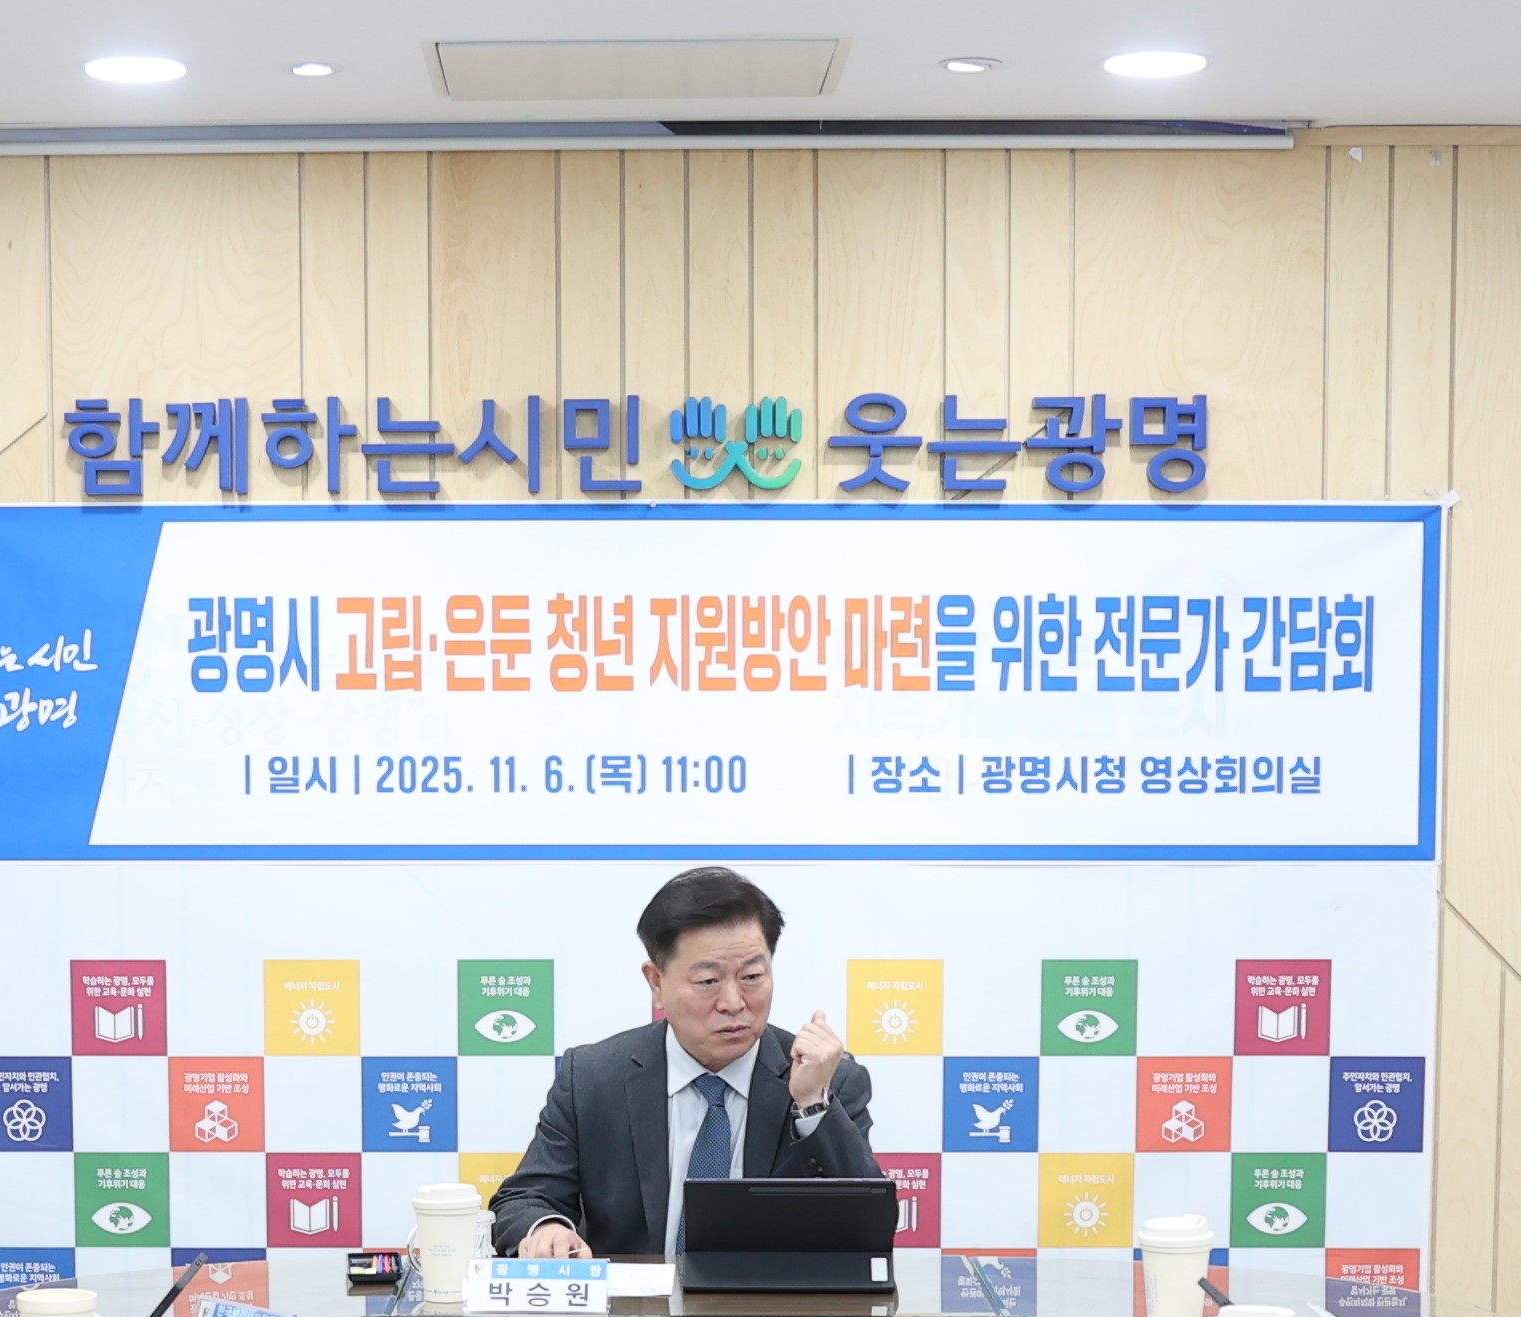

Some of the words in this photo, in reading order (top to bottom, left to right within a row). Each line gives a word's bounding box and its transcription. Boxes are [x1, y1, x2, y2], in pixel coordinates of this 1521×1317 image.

[63, 394, 642, 496] 함께하는시민
[828, 392, 1208, 493] 웃는광명
[188, 596, 319, 692] 광명시
[336, 595, 531, 691] 고립·은둔
[548, 594, 633, 691] 청년
[650, 596, 830, 691] 지원방안
[845, 595, 976, 691] 마련을
[992, 593, 1082, 692] 위한
[1095, 595, 1229, 692] 전문가
[1243, 594, 1374, 692] 간담회
[268, 756, 336, 793] 일시
[377, 755, 473, 794] 2025.
[490, 756, 527, 792] 11.
[662, 755, 746, 793] 11:00
[872, 756, 941, 793] 장소
[981, 755, 1125, 794] 광명시청
[1141, 756, 1320, 794] 영상회의실
[495, 1263, 601, 1278] 광명시장
[488, 1281, 589, 1307] 박승원
